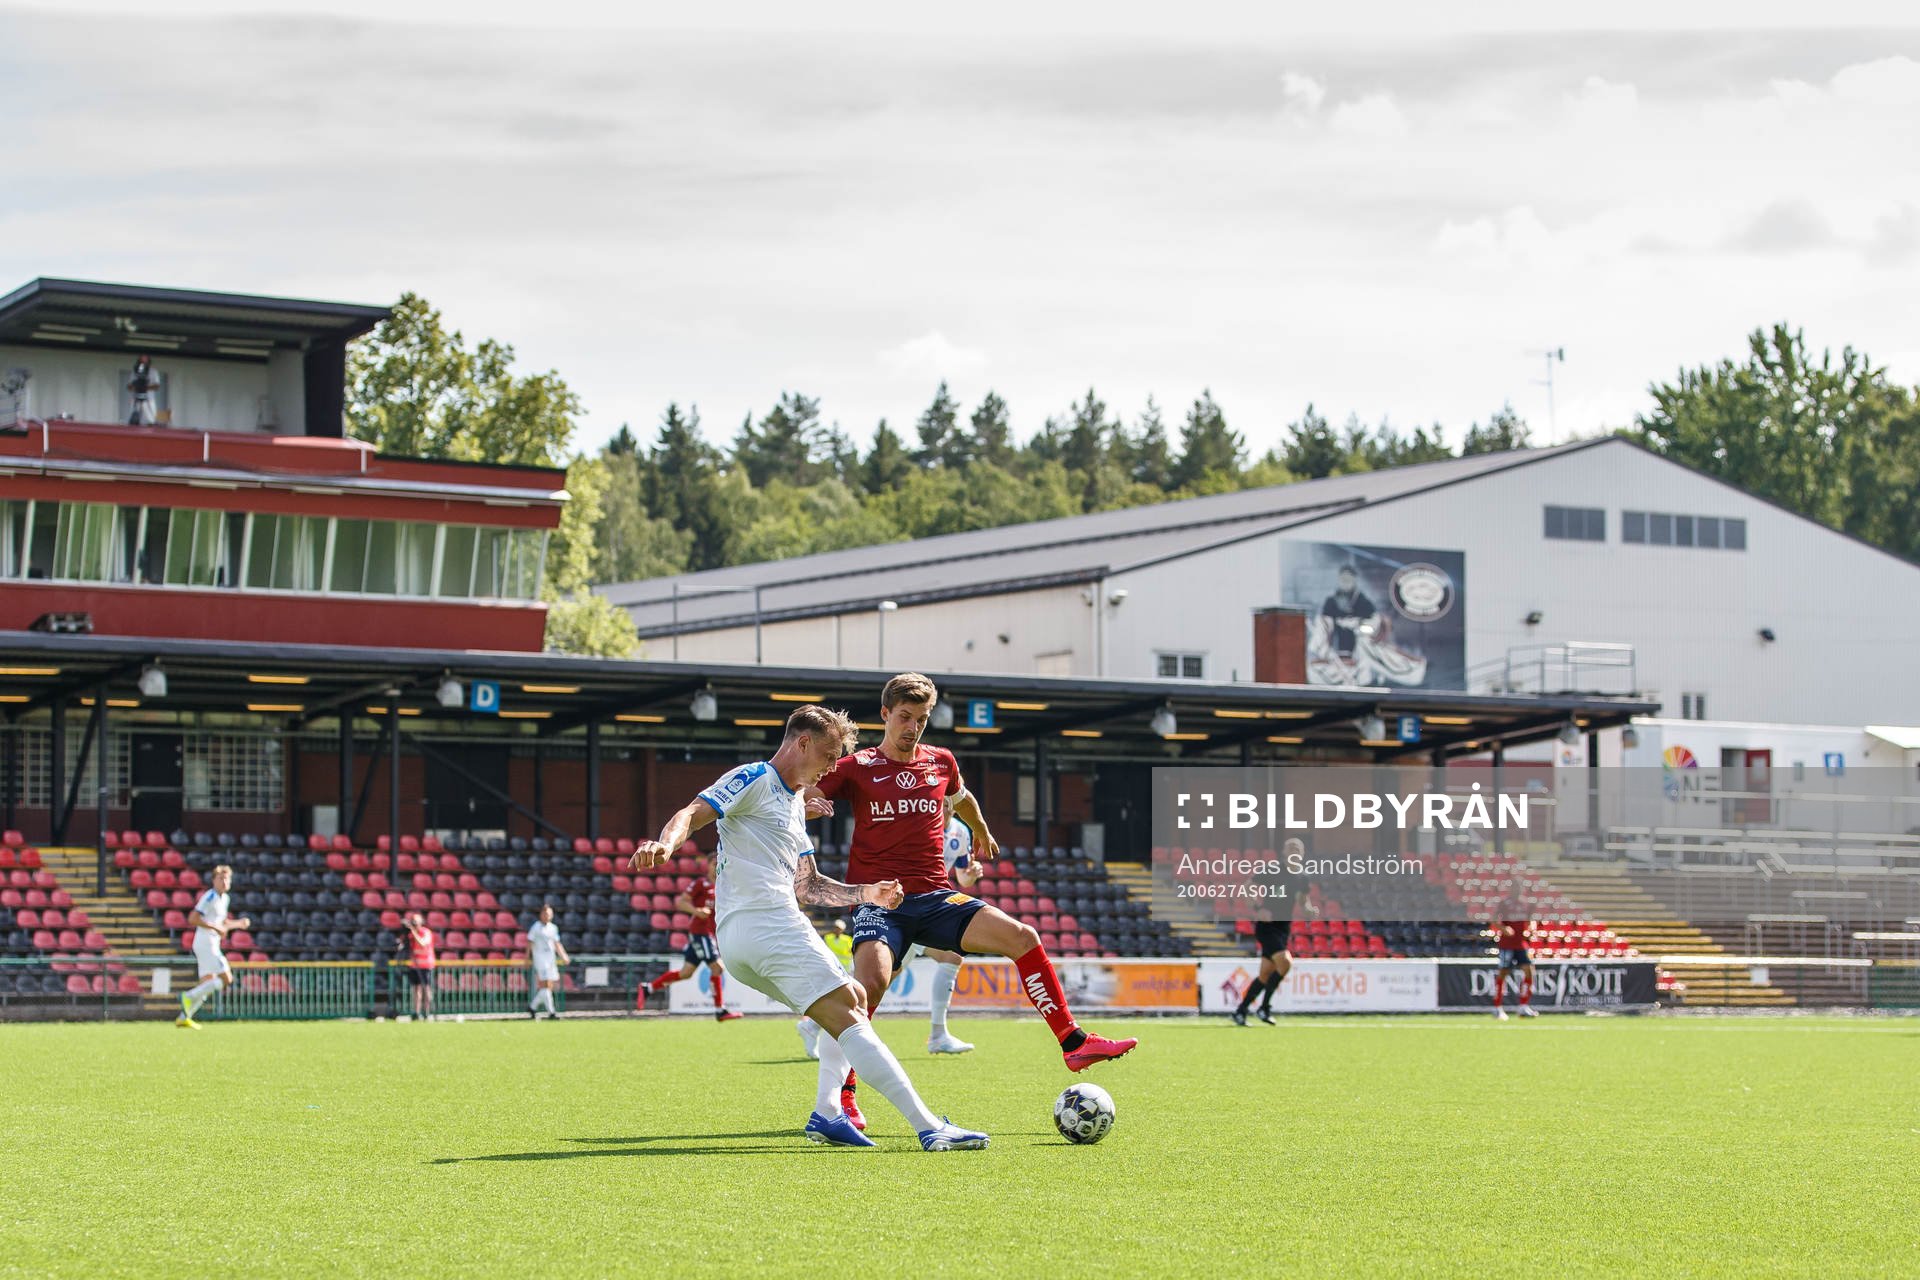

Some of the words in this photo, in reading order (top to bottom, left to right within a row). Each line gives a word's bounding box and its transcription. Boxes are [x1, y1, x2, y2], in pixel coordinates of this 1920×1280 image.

[477, 684, 494, 707] D
[974, 703, 988, 725] E
[1402, 718, 1415, 739] E
[870, 801, 895, 816] H.A
[898, 799, 937, 814] BYGG
[1568, 965, 1628, 996] KÖTT
[1025, 972, 1059, 1018] MIKE
